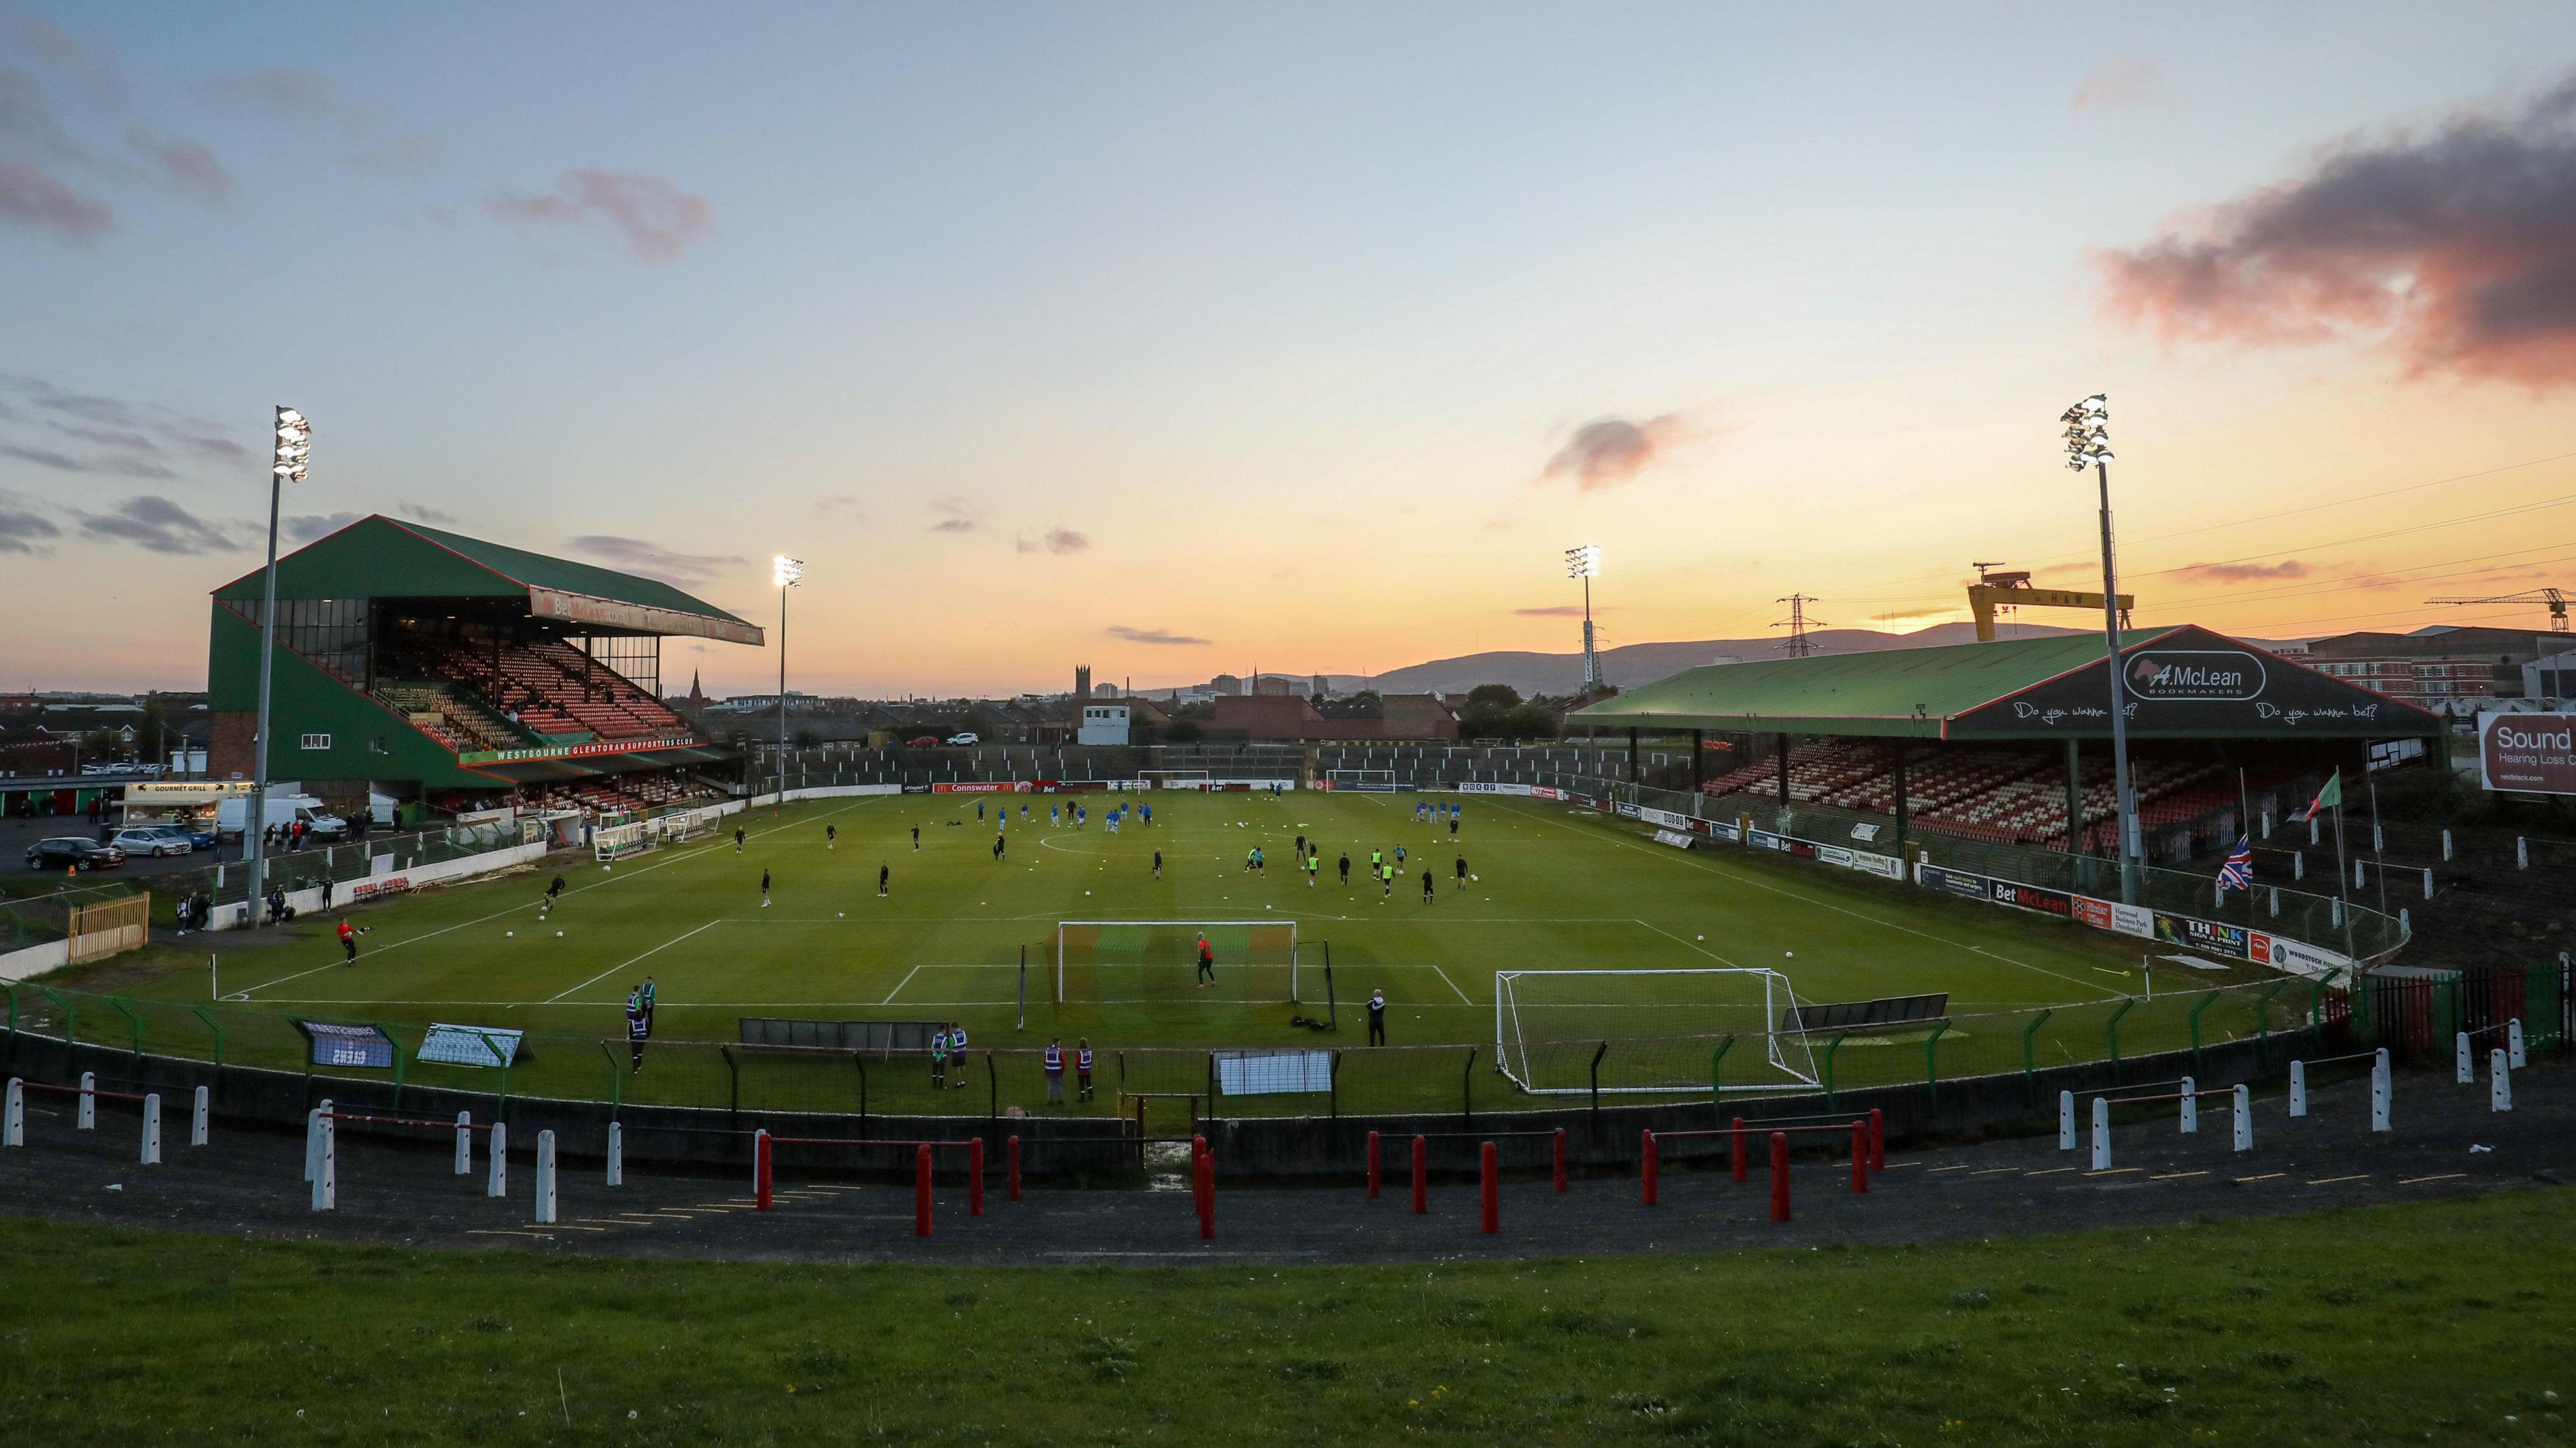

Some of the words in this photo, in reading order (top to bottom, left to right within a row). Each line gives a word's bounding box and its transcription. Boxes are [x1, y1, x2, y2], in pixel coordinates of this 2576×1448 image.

[2051, 592, 2057, 603] H
[2075, 594, 2082, 604] W
[2014, 702, 2039, 718] Do
[2042, 708, 2068, 725] you
[2072, 707, 2108, 717] wanna
[2123, 703, 2138, 720] et?
[2256, 702, 2281, 718] Do
[2284, 709, 2309, 725] you
[2314, 708, 2348, 718] wanna
[2353, 704, 2377, 721] bet?
[2498, 726, 2571, 749] Sound
[497, 746, 570, 761] WESTBOURNE
[573, 742, 625, 755] GLENTORAN
[627, 738, 675, 750] SUPPORTERS
[676, 738, 693, 746] CLUB
[2499, 753, 2537, 766] Hearing
[2540, 754, 2565, 765] Loss
[952, 784, 998, 792] Connswater
[2115, 915, 2135, 925] Business
[2136, 920, 2147, 928] Park
[2115, 922, 2143, 934] Dundonald
[2186, 920, 2244, 942] THINK
[2189, 931, 2207, 939] SIGN
[2217, 937, 2241, 946] PRINT
[2288, 949, 2322, 966] WOODSTOCK
